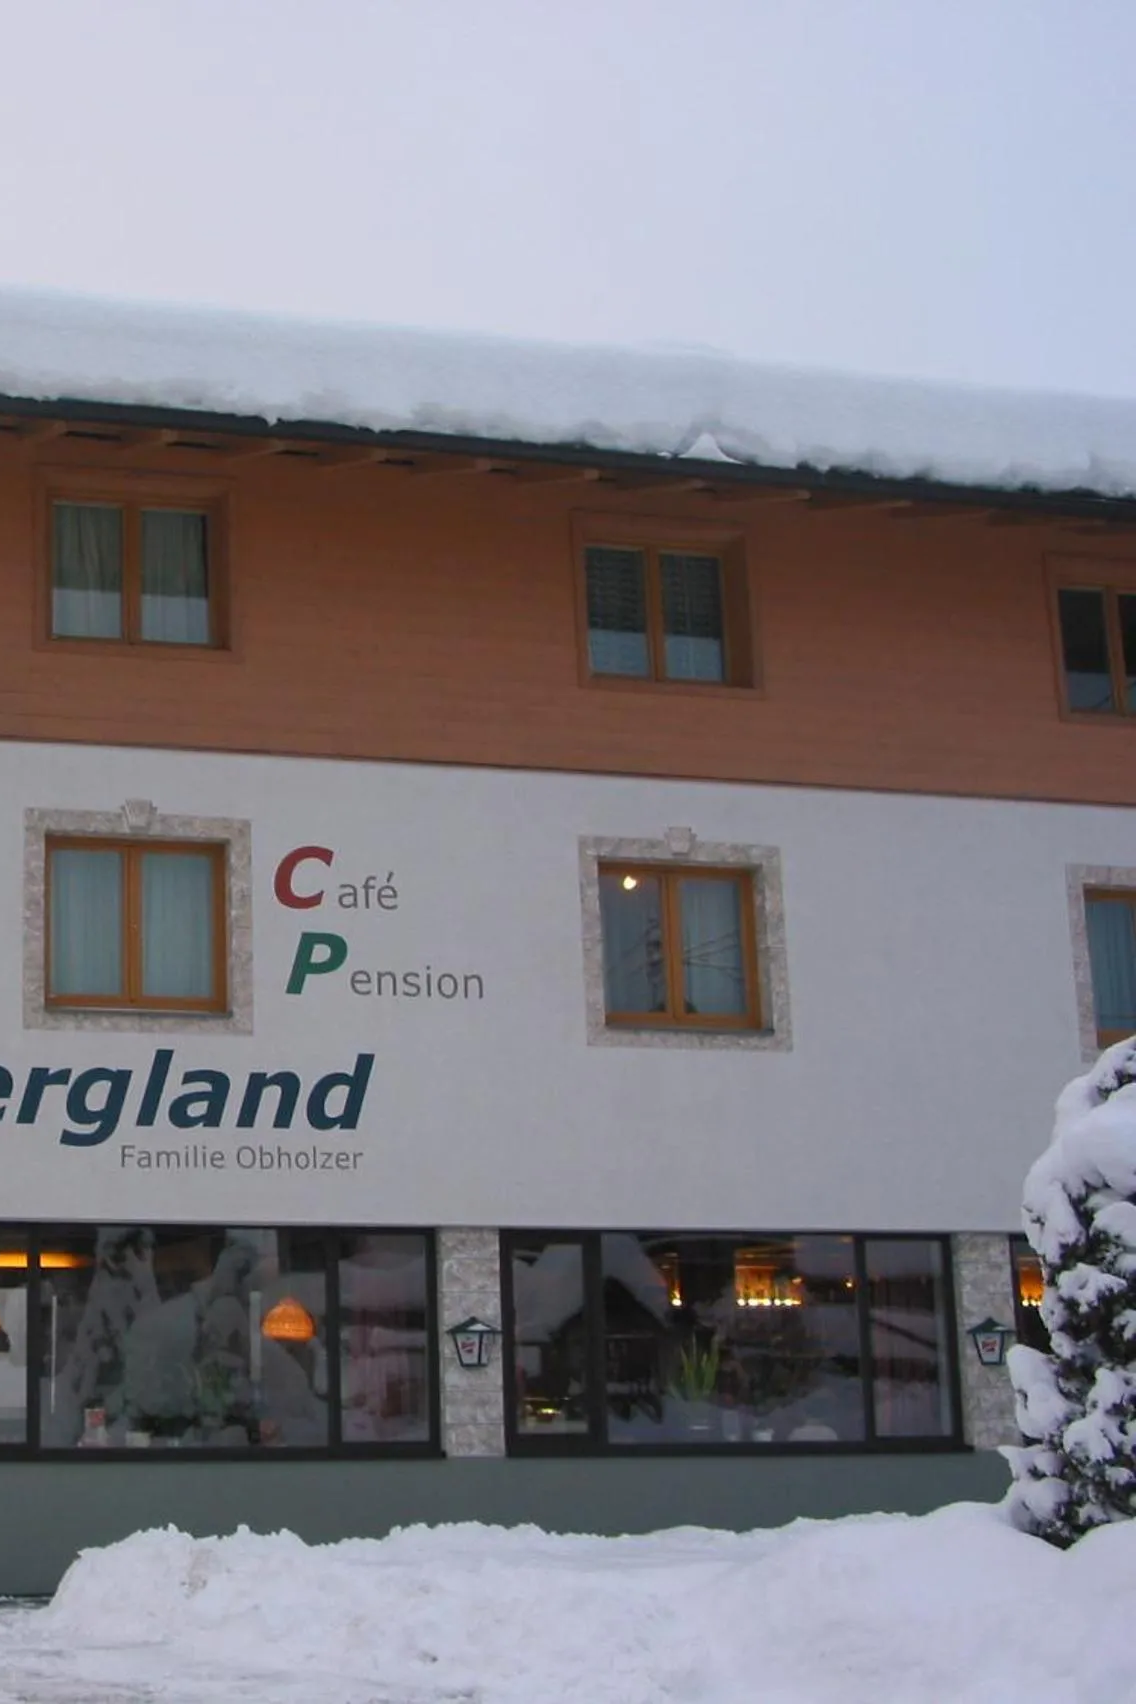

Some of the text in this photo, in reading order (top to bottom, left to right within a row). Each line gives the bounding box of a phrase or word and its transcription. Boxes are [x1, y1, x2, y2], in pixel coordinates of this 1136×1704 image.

[273, 846, 399, 911] Café
[285, 930, 484, 1000] Pension
[120, 1144, 364, 1171] Familie Obholzer
